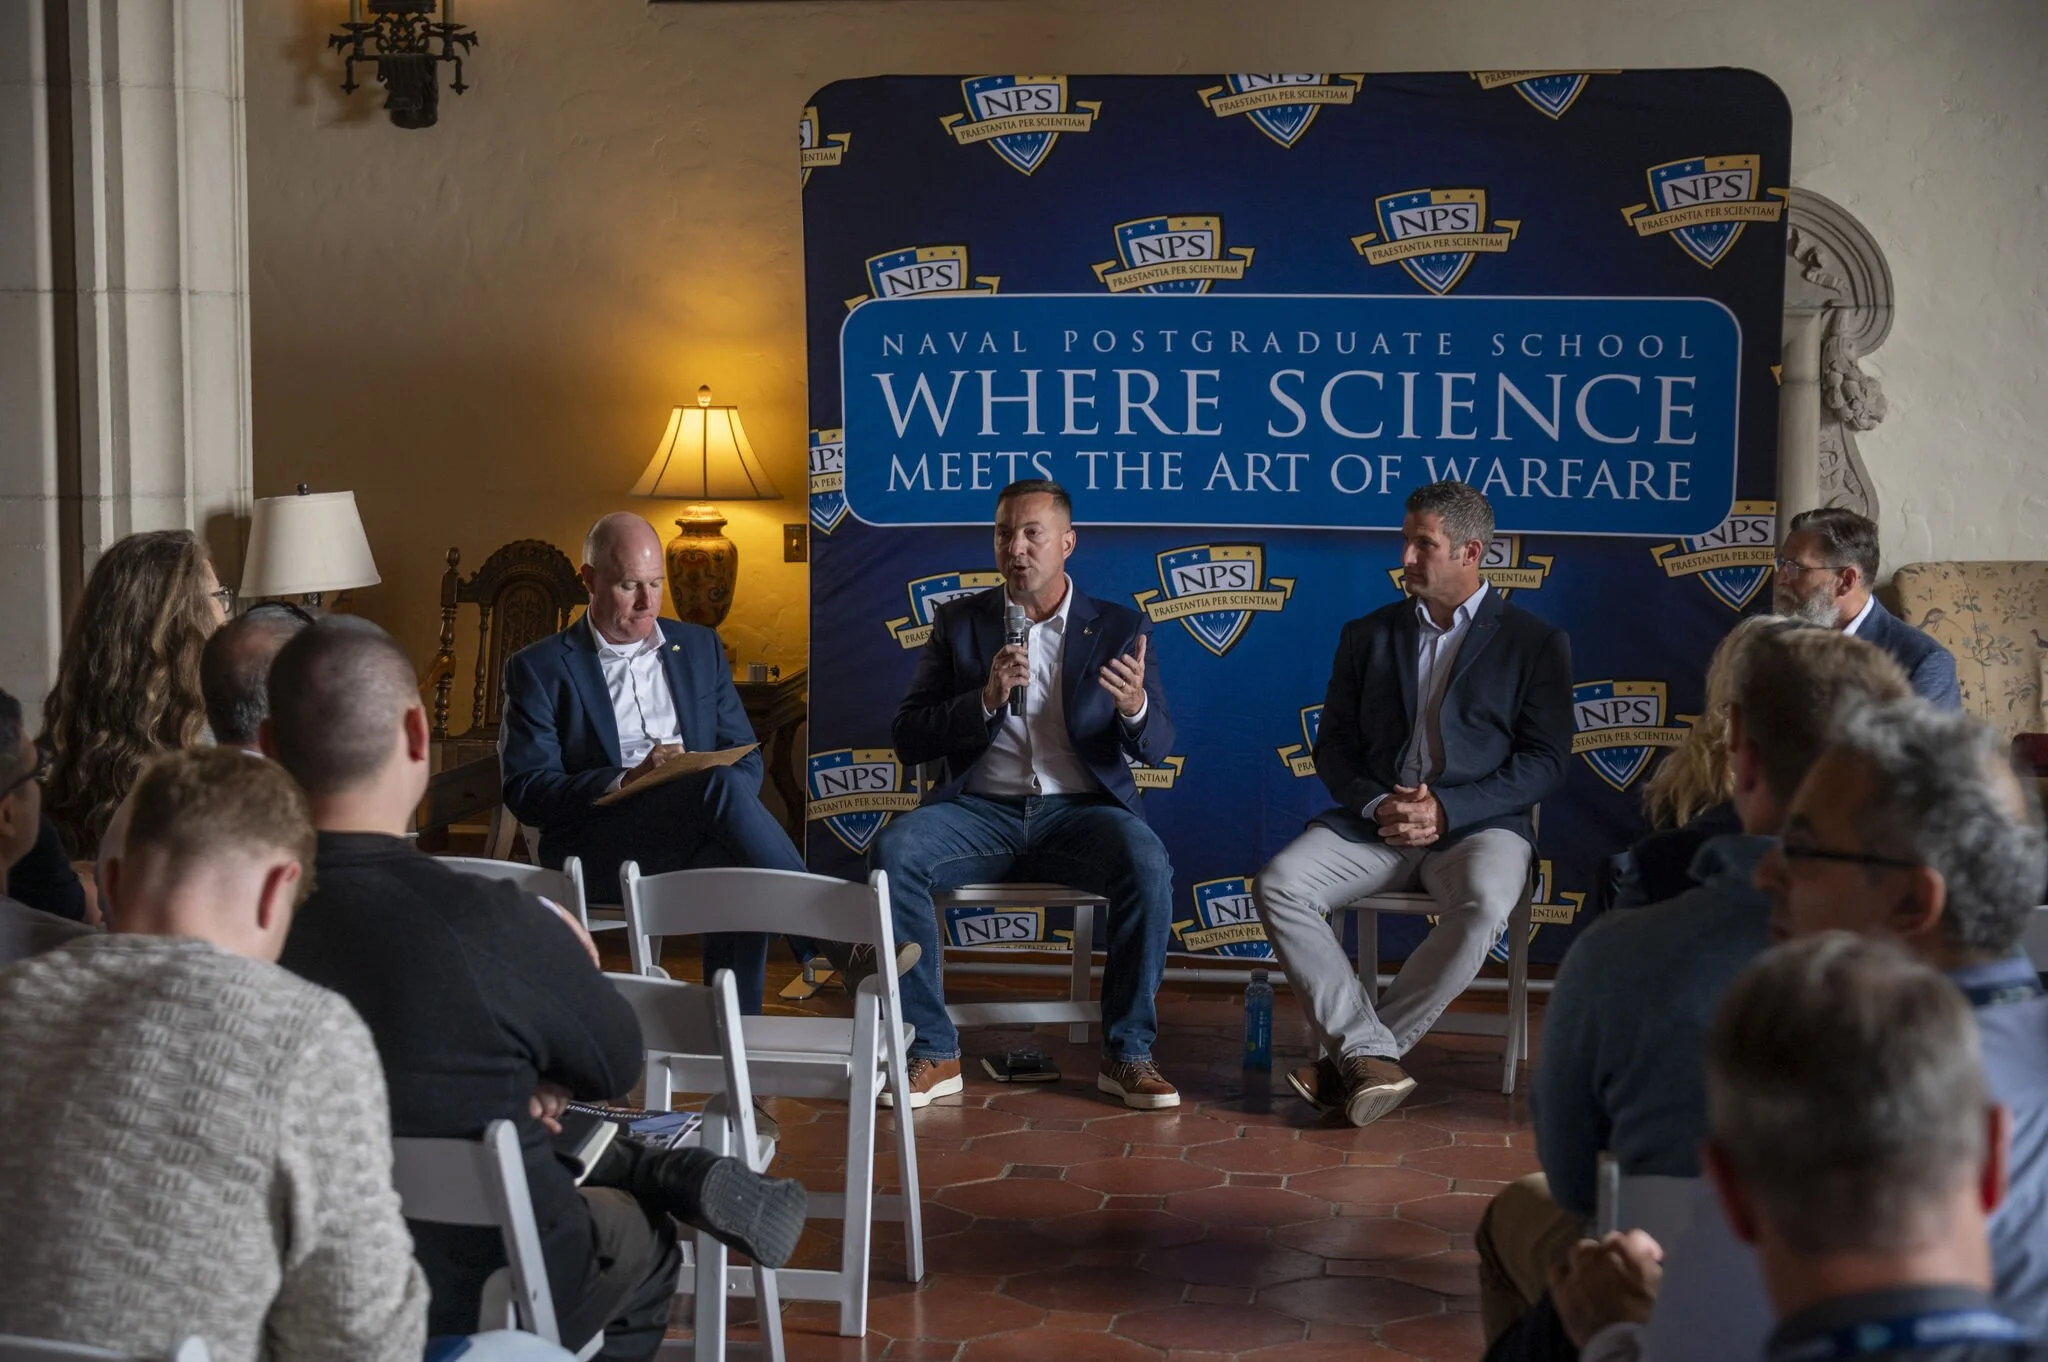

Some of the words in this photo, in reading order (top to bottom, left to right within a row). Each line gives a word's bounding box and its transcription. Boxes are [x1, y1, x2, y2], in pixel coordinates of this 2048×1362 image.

[982, 88, 1053, 117] NPS
[1218, 95, 1277, 111] PRAESTANTIA
[1279, 91, 1295, 100] PER
[1297, 90, 1348, 99] SCIENTIAM
[960, 120, 1017, 139] PRAESTANTIA
[1019, 118, 1035, 127] PER
[1037, 117, 1085, 127] SCIENTIAM
[803, 152, 837, 162] ENTIAM
[1668, 174, 1743, 206] NPS
[1397, 207, 1470, 237] NPS
[1641, 210, 1703, 230] PRAESTANTIA
[1705, 207, 1722, 217] PER
[1724, 206, 1775, 216] SCIENTIAM
[1135, 234, 1205, 264] NPS
[1372, 240, 1431, 260] PRAESTANTIA
[1433, 239, 1450, 248] PER
[1452, 237, 1503, 247] SCIENTIAM
[885, 264, 953, 296] NPS
[1112, 268, 1169, 288] PRAESTANTIA
[1171, 265, 1187, 275] PER
[1189, 264, 1238, 274] SCIENTIAM
[882, 330, 1028, 357] NAVAL
[1063, 329, 1453, 355] POSTGRADUATE
[1492, 332, 1695, 359] SCHOOL
[871, 368, 1223, 439] WHERE
[1267, 369, 1697, 445] SCIENCE
[886, 451, 1053, 492] MEETS
[1076, 451, 1184, 492] THE
[1203, 452, 1310, 493] ART
[1330, 454, 1402, 495] OF
[1420, 456, 1692, 501] WARFARE
[1671, 552, 1730, 572] PRAESTANTIA
[1732, 551, 1748, 560] PER
[1177, 564, 1246, 593] NPS
[1487, 573, 1536, 583] SCIENTIAM
[1154, 598, 1210, 616] PRAESTANTIA
[1212, 596, 1228, 605] PER
[1230, 595, 1278, 606] SCIENTIAM
[1579, 700, 1650, 728] NPS
[1574, 734, 1613, 748] STANTIA
[1615, 732, 1631, 741] PER
[1633, 731, 1683, 741] SCIENTIAM
[821, 767, 887, 795] NPS
[1135, 773, 1168, 783] ENTIAM
[808, 799, 852, 815] AESTANTIA
[854, 797, 870, 806] PER
[871, 796, 918, 806] SCIENTIAM
[1212, 896, 1254, 923] NP
[1532, 908, 1568, 919] ENTIAM
[962, 916, 1030, 943] NPS
[1190, 929, 1243, 946] PRAESTANTIA
[1246, 927, 1261, 936] PER
